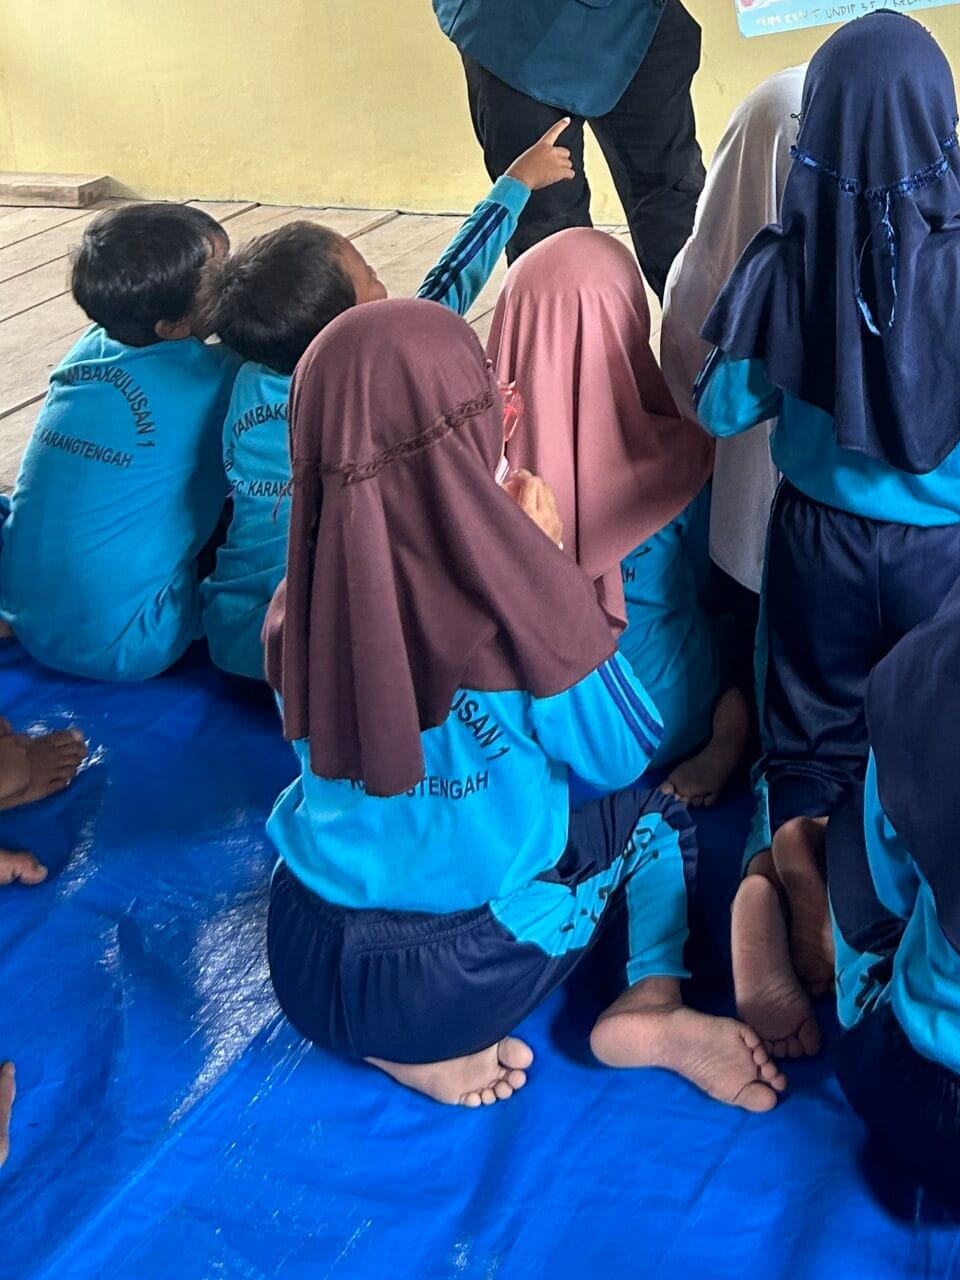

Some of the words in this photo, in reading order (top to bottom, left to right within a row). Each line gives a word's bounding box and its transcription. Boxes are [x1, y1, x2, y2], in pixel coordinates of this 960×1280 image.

[825, 3, 856, 19] UNDIP
[232, 402, 288, 439] TAMBAK
[40, 427, 134, 468] KARANGTENGAH
